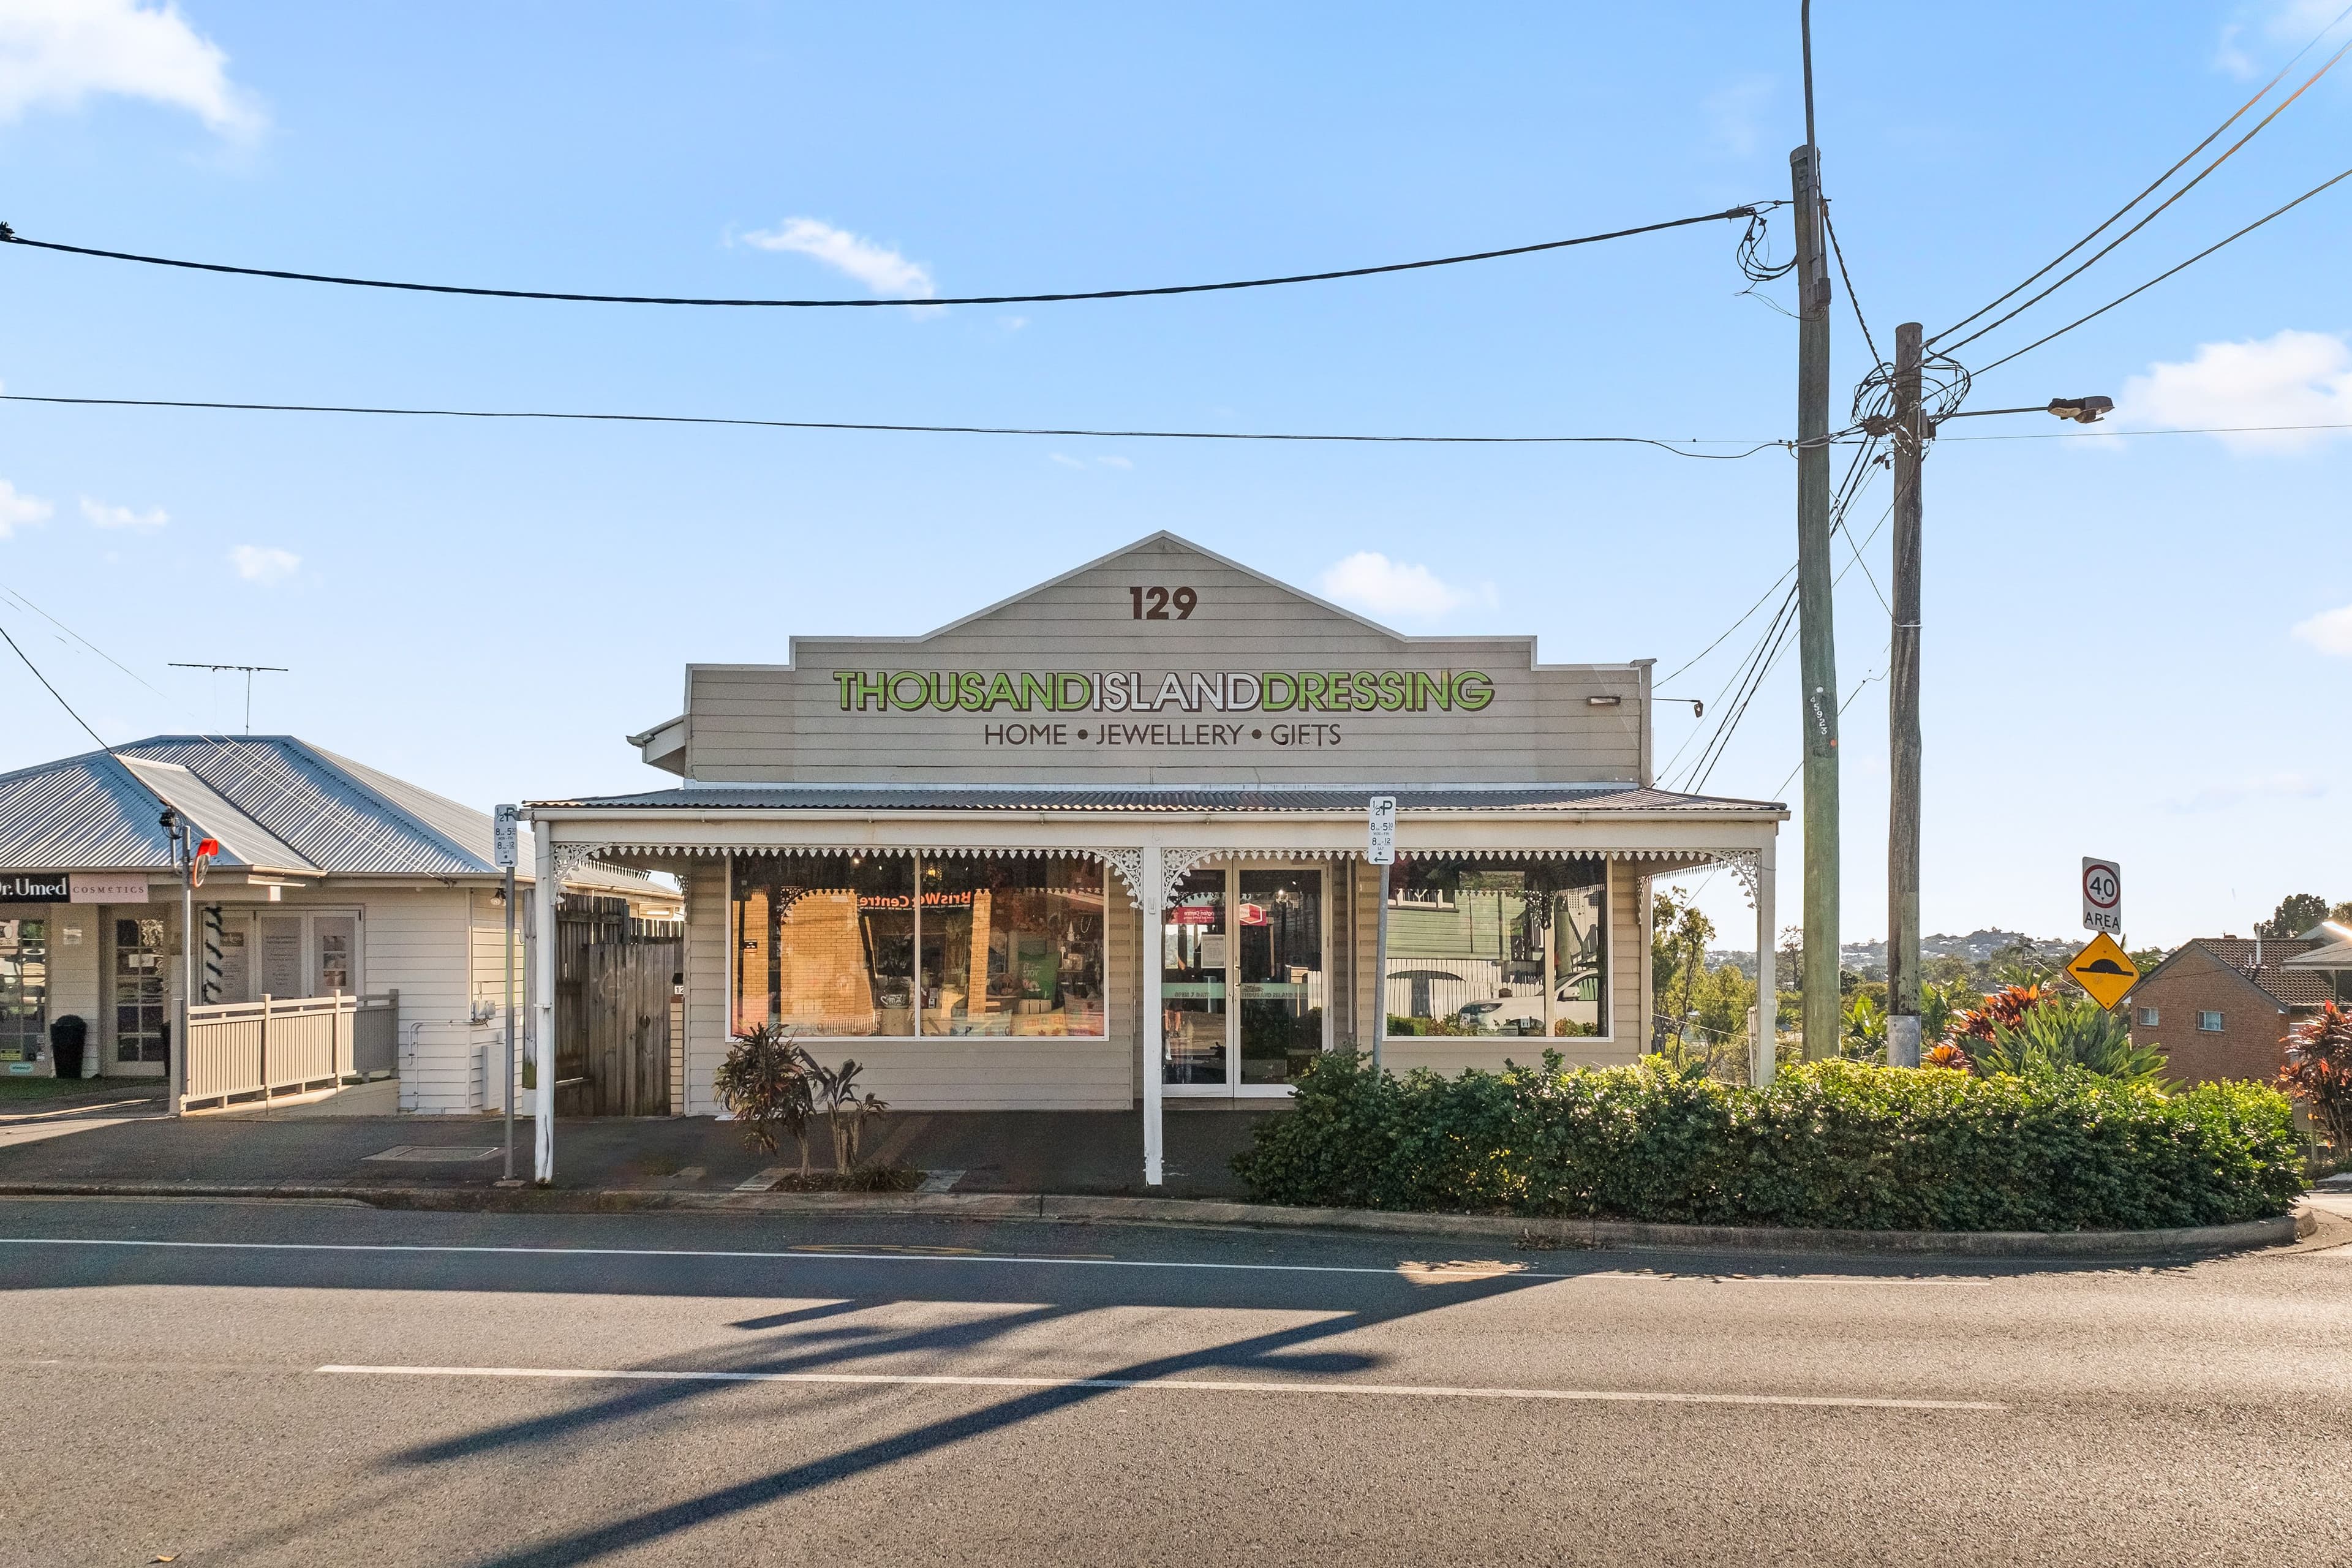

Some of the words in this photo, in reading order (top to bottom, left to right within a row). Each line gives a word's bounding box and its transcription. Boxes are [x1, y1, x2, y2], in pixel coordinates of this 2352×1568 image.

[1129, 586, 1197, 620] 129
[1810, 696, 1828, 735] 45923
[985, 724, 1067, 745] HOME
[1096, 724, 1245, 745] JEWELLERY
[1270, 724, 1341, 747] GIFTS
[0, 880, 13, 895] r.
[15, 877, 67, 895] Umed
[2089, 876, 2114, 897] 40
[2084, 911, 2120, 930] AREA
